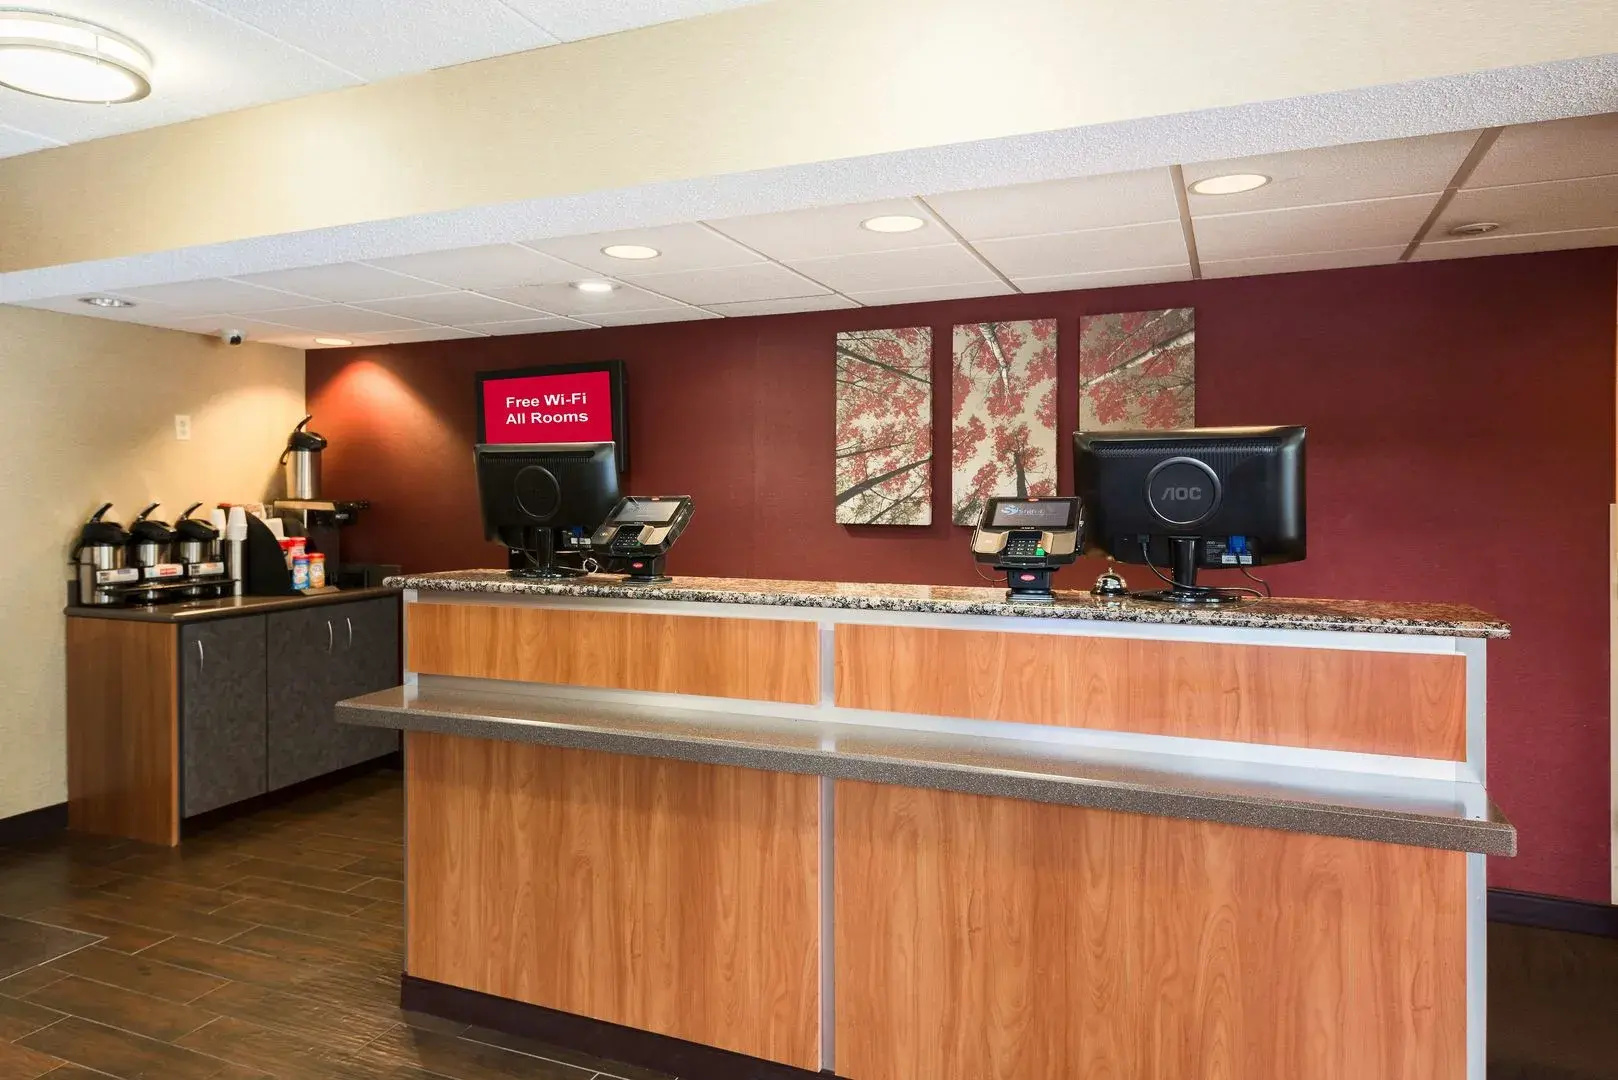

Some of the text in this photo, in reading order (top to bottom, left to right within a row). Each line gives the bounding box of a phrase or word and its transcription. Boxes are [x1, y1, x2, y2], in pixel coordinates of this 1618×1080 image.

[506, 392, 587, 408] Free Wi-Fi
[505, 412, 589, 425] All Rooms
[1161, 486, 1202, 502] AOC
